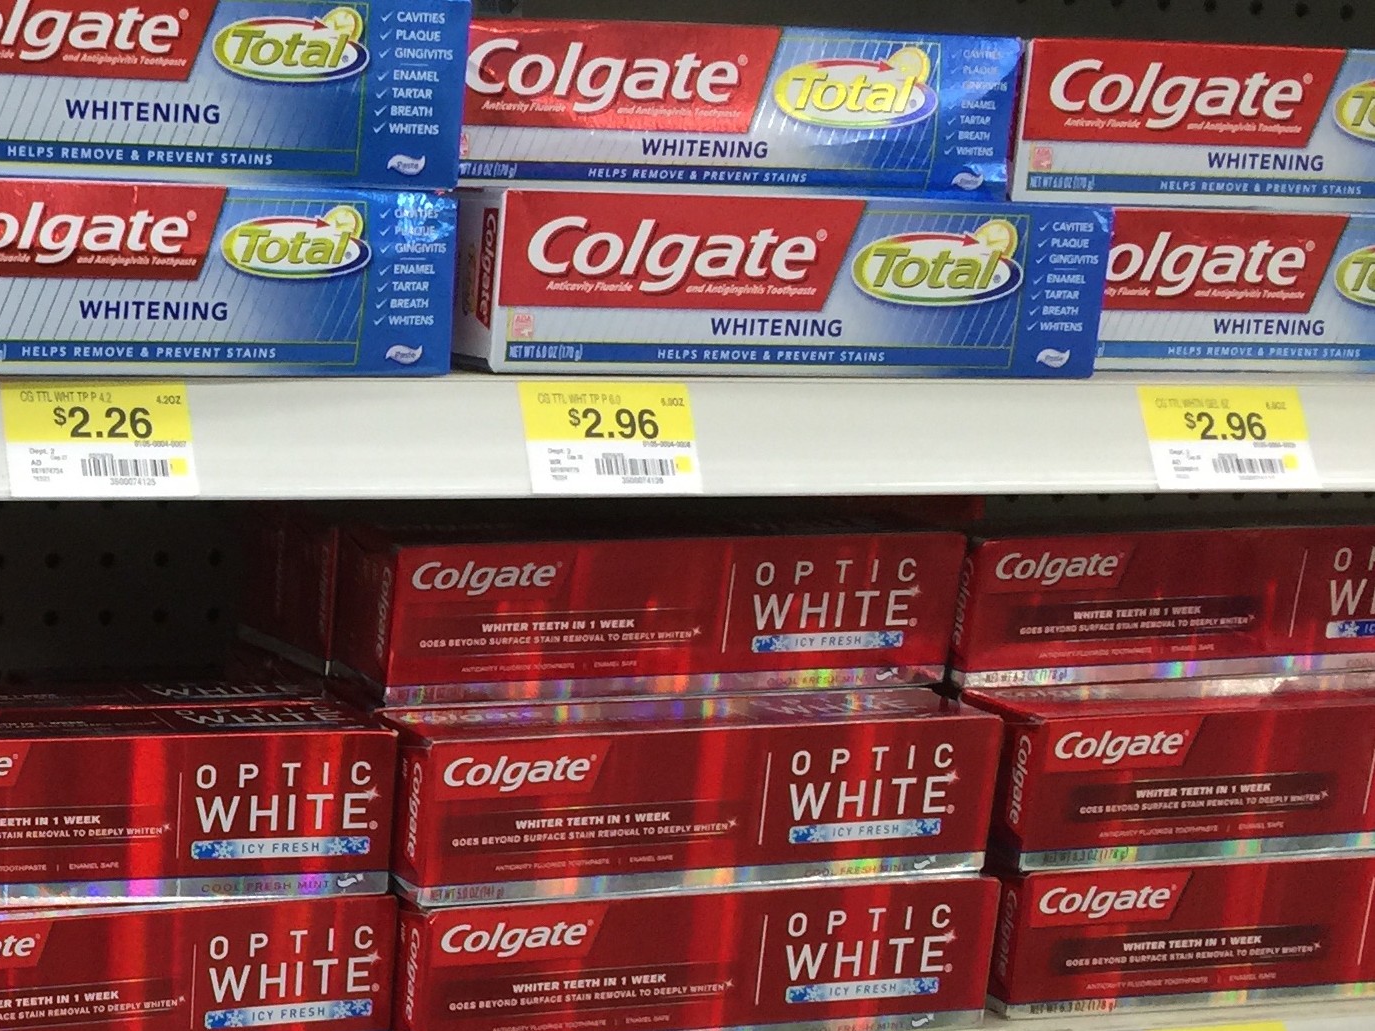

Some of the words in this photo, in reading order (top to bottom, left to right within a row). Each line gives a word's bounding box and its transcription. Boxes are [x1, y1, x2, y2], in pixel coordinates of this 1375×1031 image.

[396, 12, 445, 24] CAVITIES
[232, 29, 342, 69] Total
[396, 30, 440, 43] PLAQUE
[395, 48, 453, 61] GINGIVITIS
[393, 70, 439, 83] ENAMEL
[466, 36, 738, 113] Colgate
[392, 88, 432, 99] TARTAR
[65, 98, 220, 125] WHITENING
[390, 106, 432, 117] BREATH
[388, 124, 439, 136] WHITENS
[8, 146, 53, 159] HELPS
[61, 147, 122, 161] REMOVE
[130, 152, 140, 164] &
[147, 151, 215, 165] PREVENT
[221, 152, 273, 166] STAINS
[1207, 152, 1324, 172] WHITENING
[527, 215, 817, 296] Colgate
[870, 249, 1003, 290] Total
[1106, 231, 1305, 296] olgate
[79, 300, 228, 322] WHITENING
[711, 317, 842, 338] WHITENING
[53, 406, 153, 439] $2.26
[568, 408, 660, 440] $2.96
[1185, 411, 1267, 441] $2.96
[411, 560, 557, 597] Colgate
[1053, 731, 1185, 764] Colgate
[195, 761, 373, 790] OPTIC
[442, 754, 591, 792] Colgate
[35, 815, 49, 827] IN
[52, 815, 59, 826] 1
[64, 814, 100, 826] WEEK
[194, 793, 370, 834] WHITE
[26, 829, 70, 839] REMOVAL
[72, 828, 85, 838] TO
[88, 827, 124, 837] DEEPLY
[127, 825, 162, 836] WHITEN
[240, 842, 266, 855] ICY
[273, 840, 320, 854] FRESH
[208, 924, 374, 960] OPTIC
[208, 956, 372, 1002] WHITE
